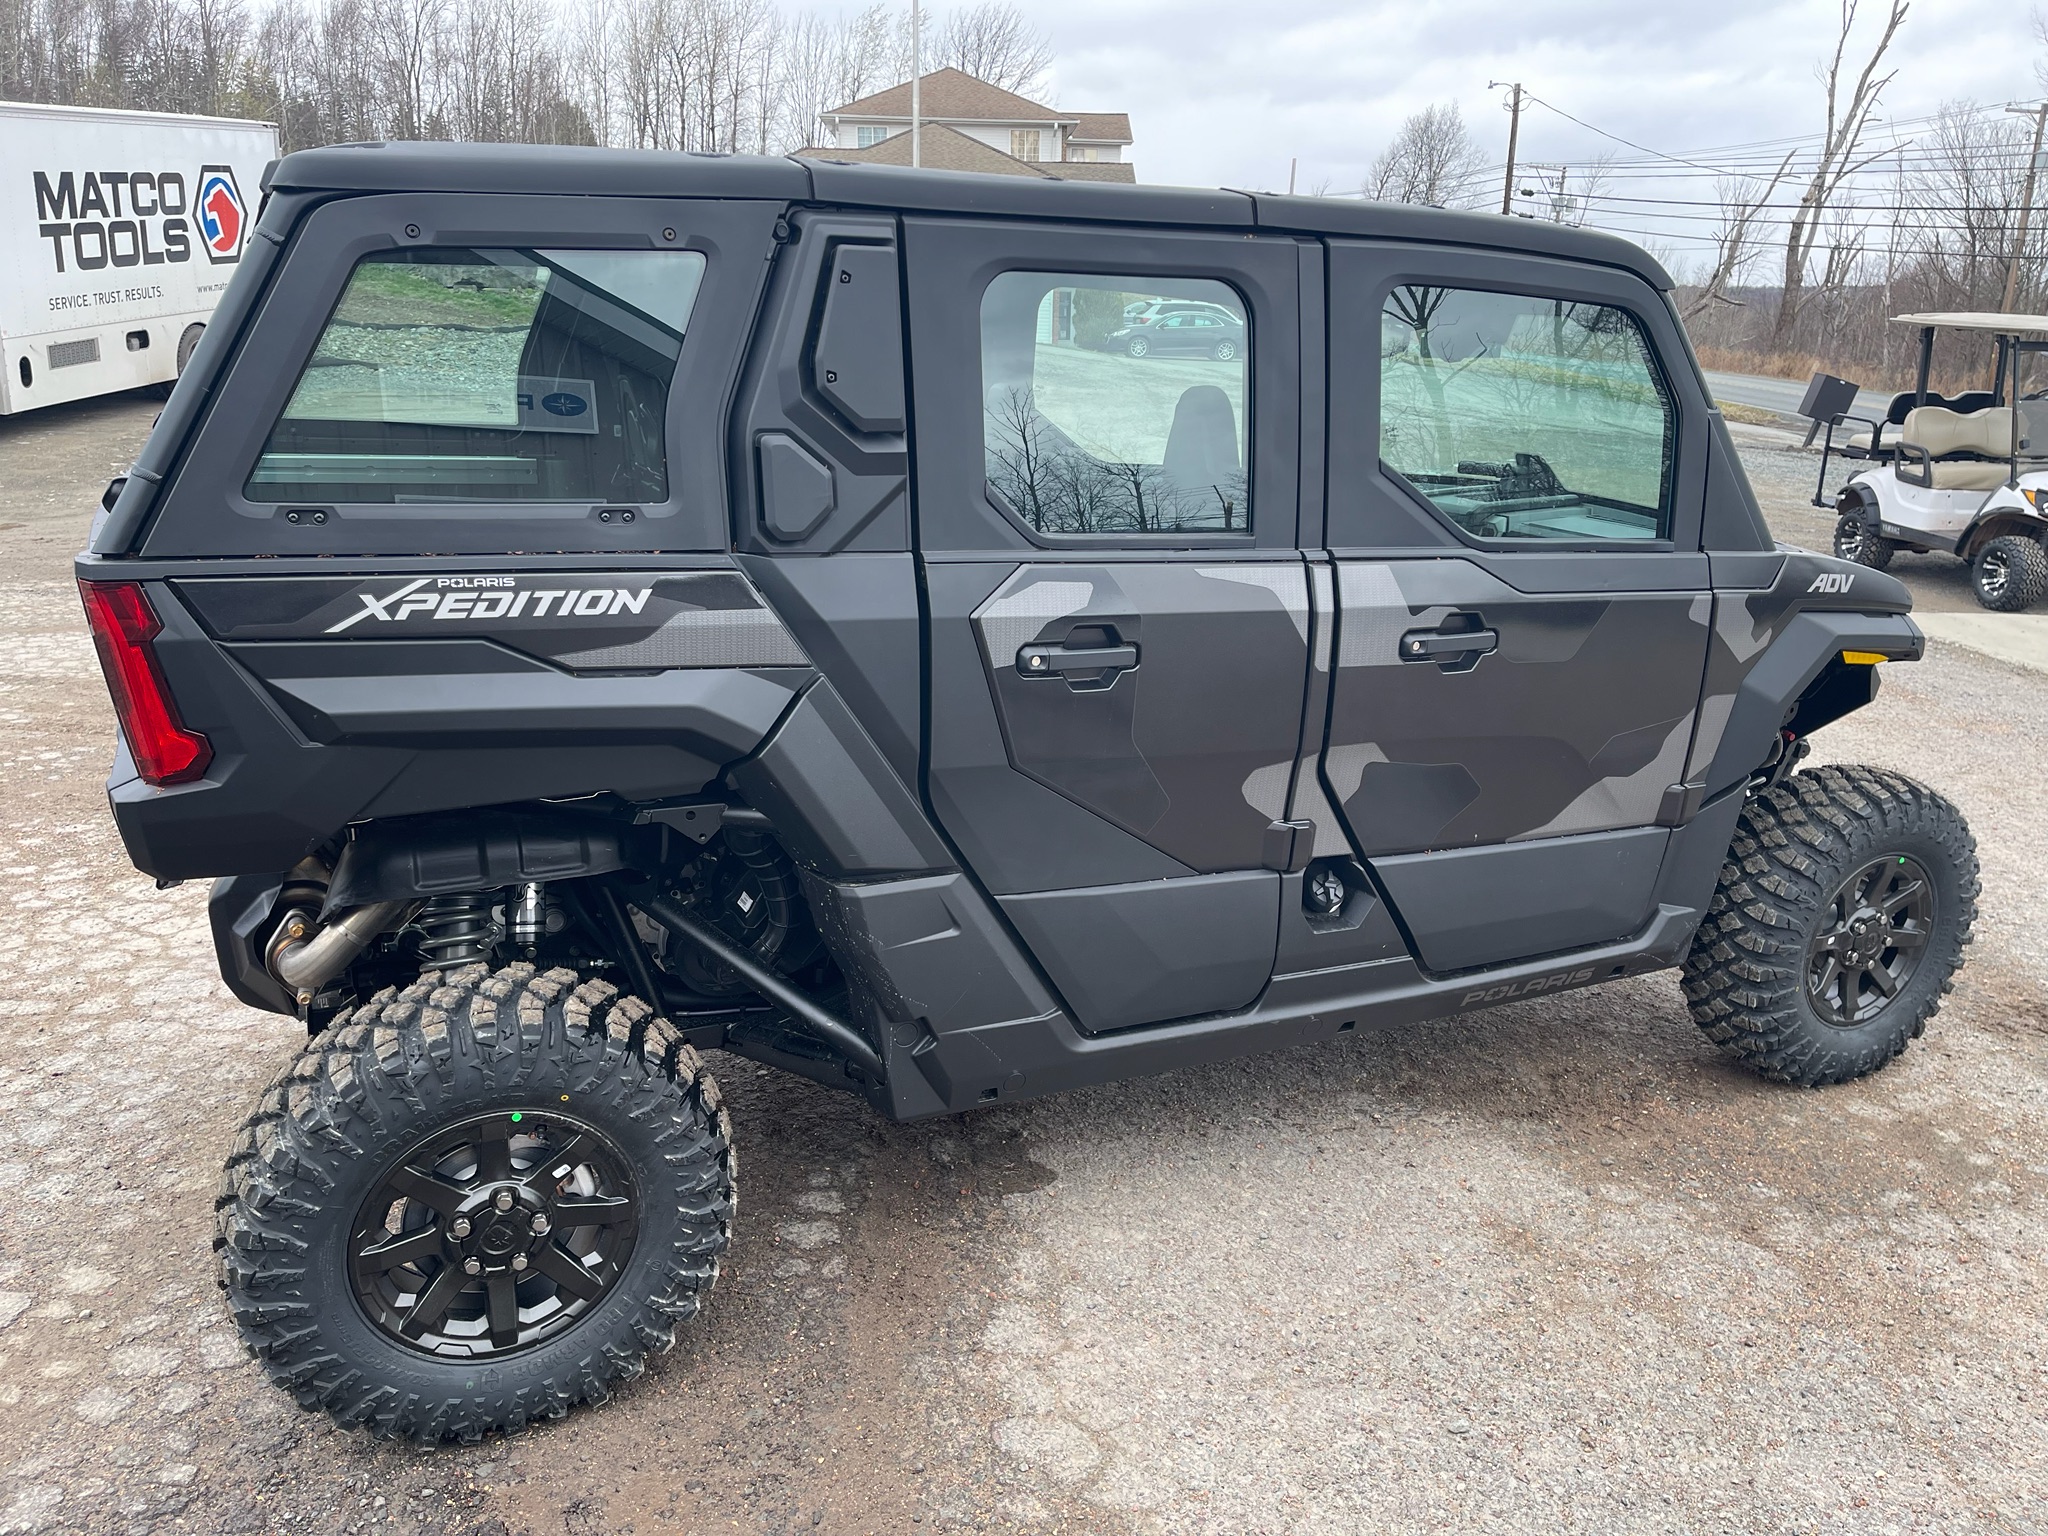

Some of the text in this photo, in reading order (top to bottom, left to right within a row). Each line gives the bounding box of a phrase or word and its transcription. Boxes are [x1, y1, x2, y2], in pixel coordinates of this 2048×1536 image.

[33, 171, 186, 220] MATCO
[39, 218, 191, 273] TOOLS
[49, 286, 164, 311] SERVICE. TRUST. RESULTS.
[437, 577, 516, 588] POLARIS
[1806, 573, 1855, 593] ADV
[324, 579, 653, 633] XPEDITION
[1459, 967, 1596, 1007] POLARIS
